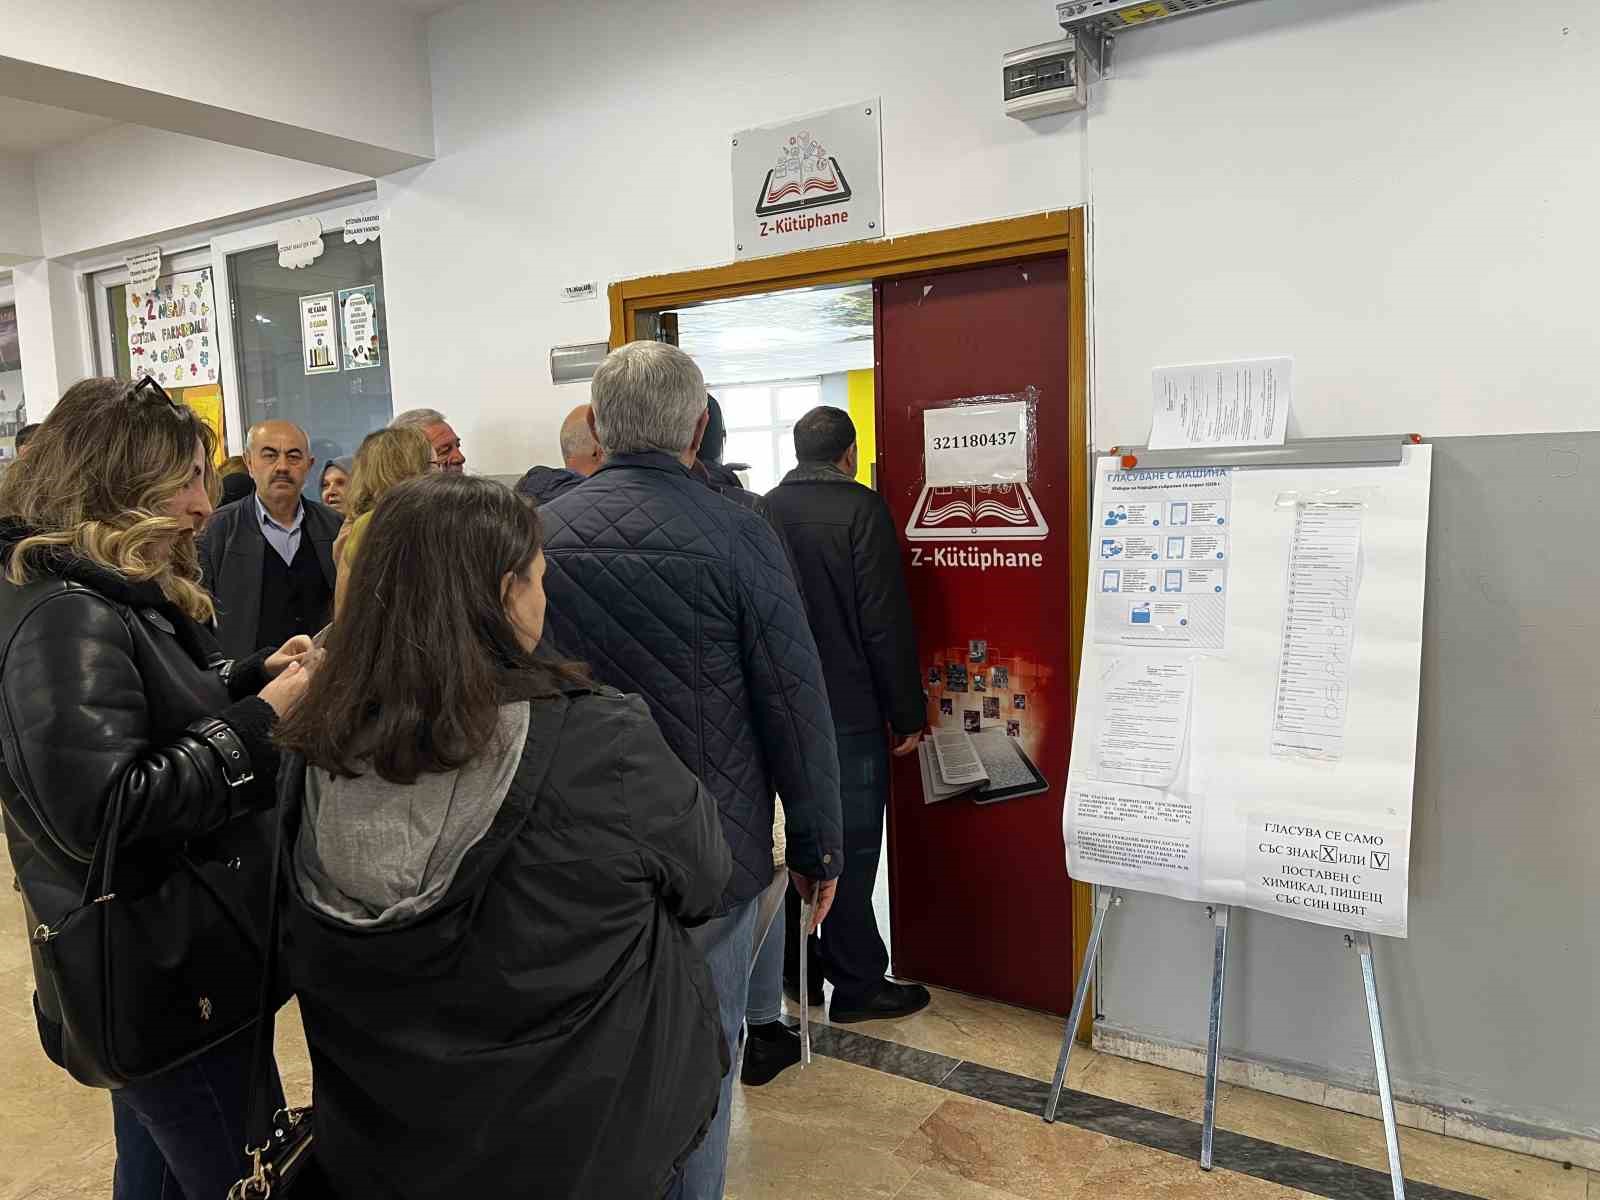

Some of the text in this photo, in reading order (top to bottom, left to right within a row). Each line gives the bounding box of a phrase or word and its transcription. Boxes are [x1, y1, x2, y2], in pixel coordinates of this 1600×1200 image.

[760, 211, 849, 237] Z-Kütüphane
[146, 299, 156, 320] 2
[933, 431, 1017, 450] 321180437
[1107, 468, 1226, 482] ГЛАСУВАНЕ С МАШИНА
[911, 547, 1043, 571] Z-Kütüphane
[1264, 822, 1384, 846] ГЛАСУВА СЕ САМО
[1259, 843, 1284, 854] СЪС
[1286, 846, 1319, 859] ЗНАК
[1339, 853, 1366, 865] ИЛИ
[1371, 852, 1388, 868] V
[1282, 865, 1361, 885] ПОСТАВЕН С
[1262, 876, 1384, 904] ХИМИКАЛ, ПИШЕЩ
[1276, 893, 1368, 916] СЪС СИН ЦВЯТ
